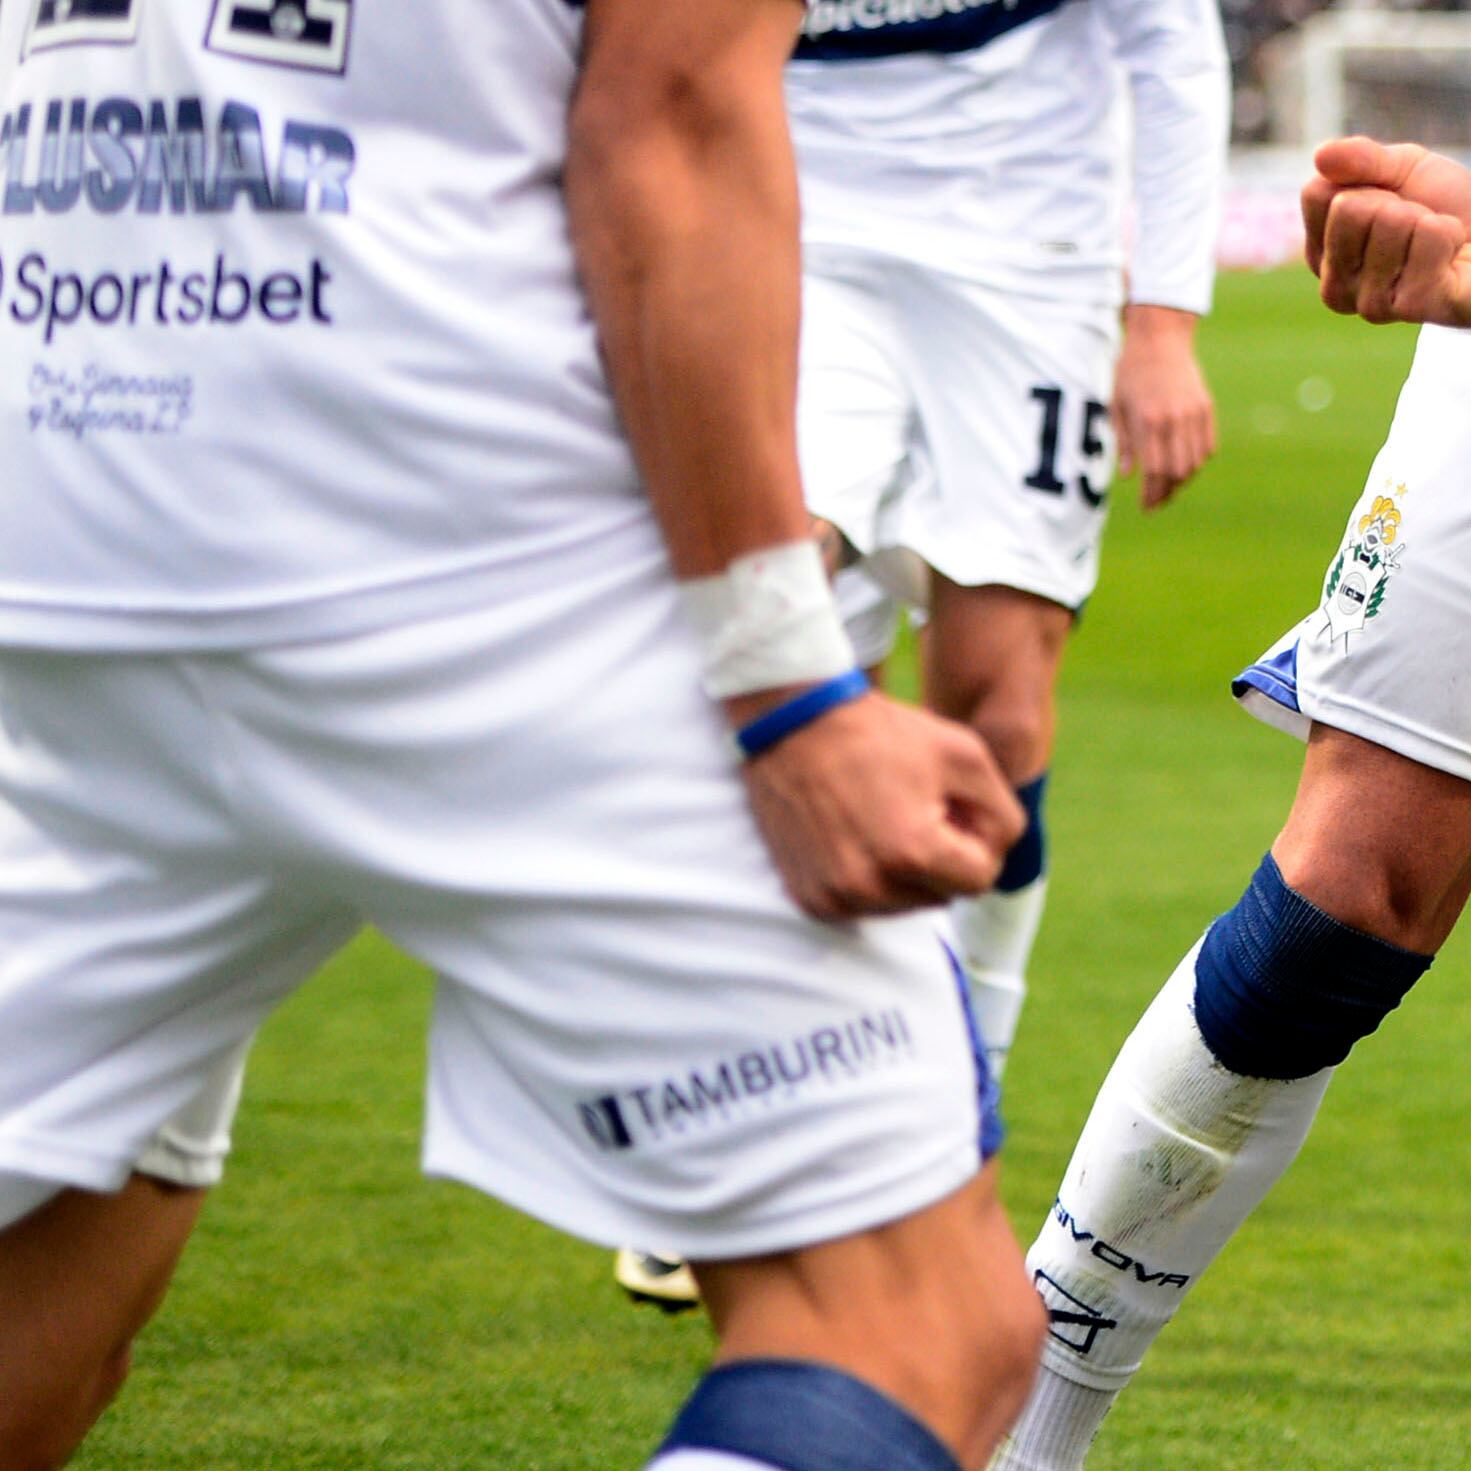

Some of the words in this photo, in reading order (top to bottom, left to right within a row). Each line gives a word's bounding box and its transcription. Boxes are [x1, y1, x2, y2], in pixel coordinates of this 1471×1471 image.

[0, 96, 356, 216] LUSMAR
[10, 253, 332, 346] Sportsbet
[1023, 386, 1112, 507] 15
[626, 1008, 914, 1129] TAMBURINI
